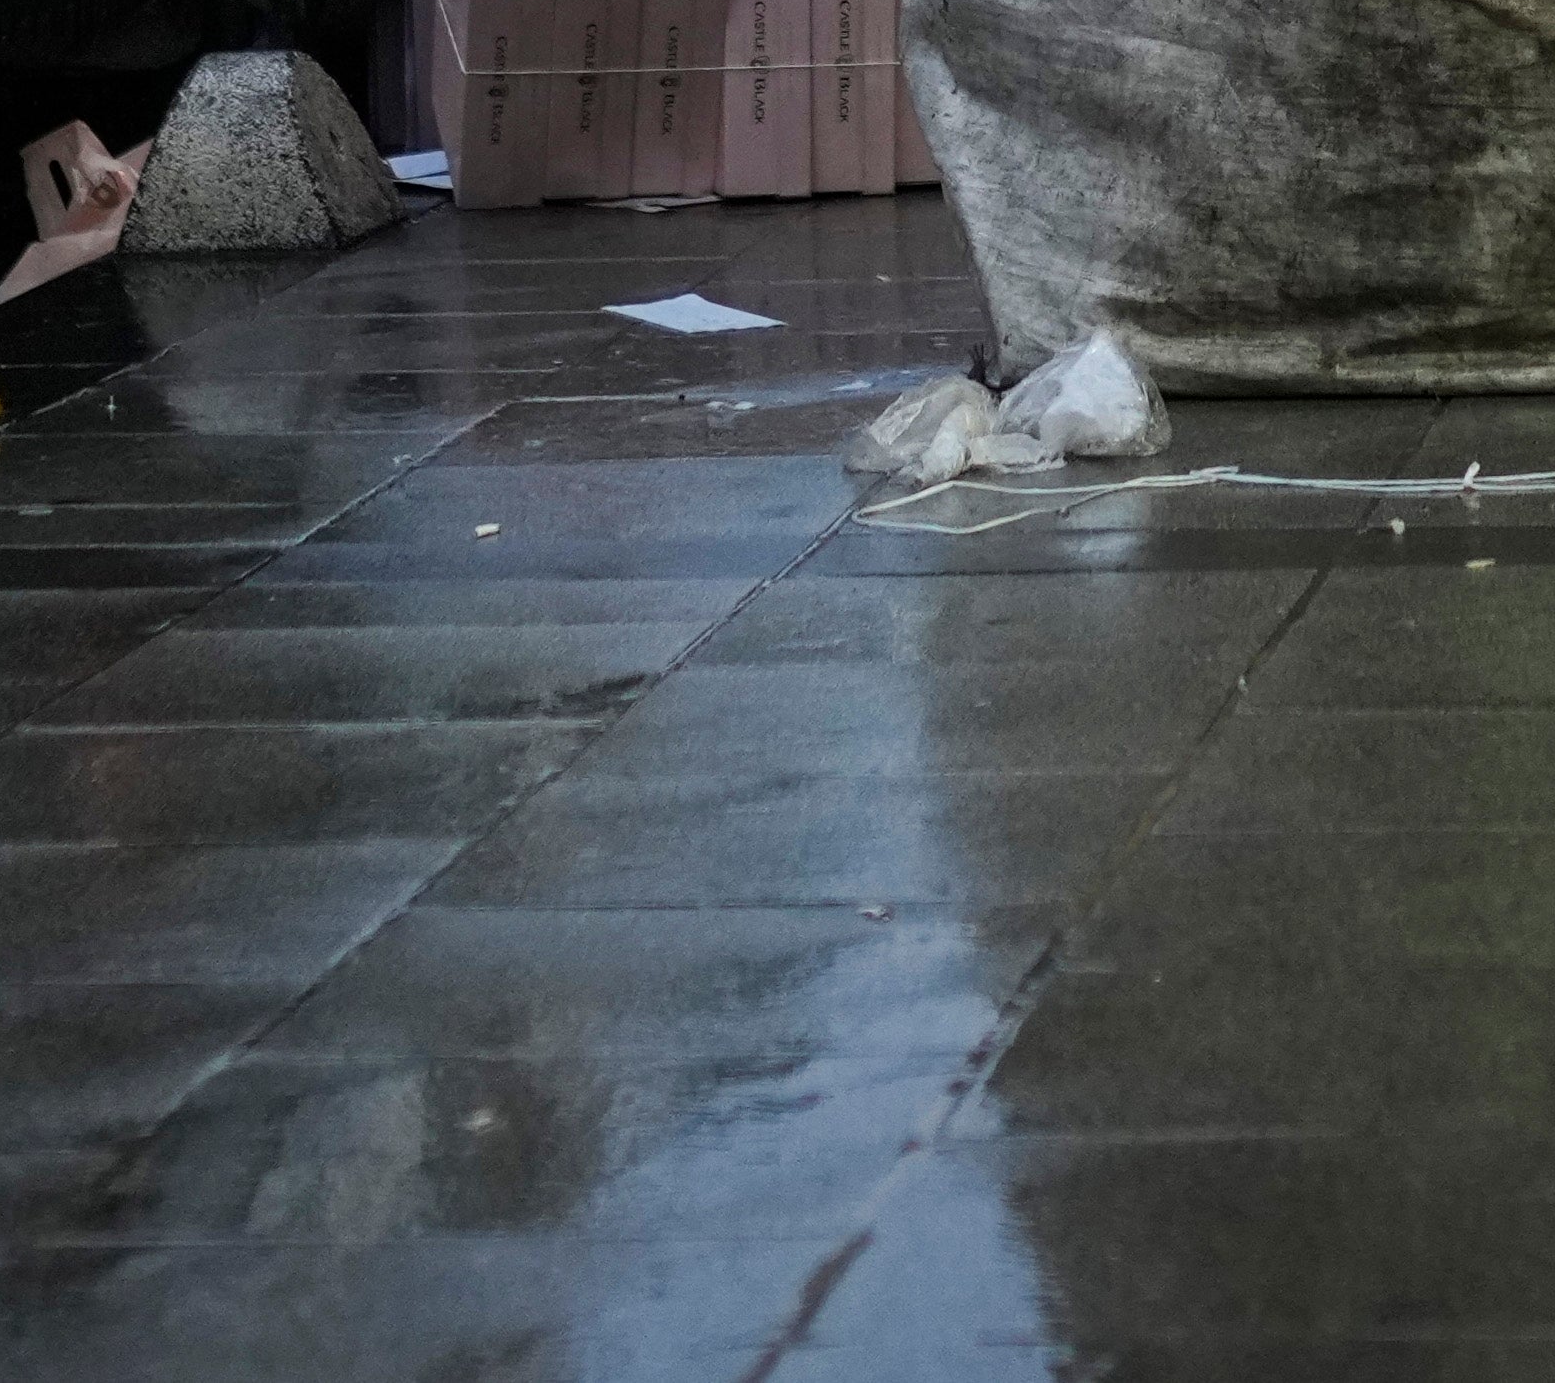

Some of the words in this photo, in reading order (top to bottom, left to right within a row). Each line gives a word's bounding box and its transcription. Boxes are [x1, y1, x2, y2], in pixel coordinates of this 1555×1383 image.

[754, 1, 766, 53] CASTLE
[839, 0, 852, 52] CASTLE
[754, 78, 766, 125] BLACK
[839, 76, 851, 123] BLACK
